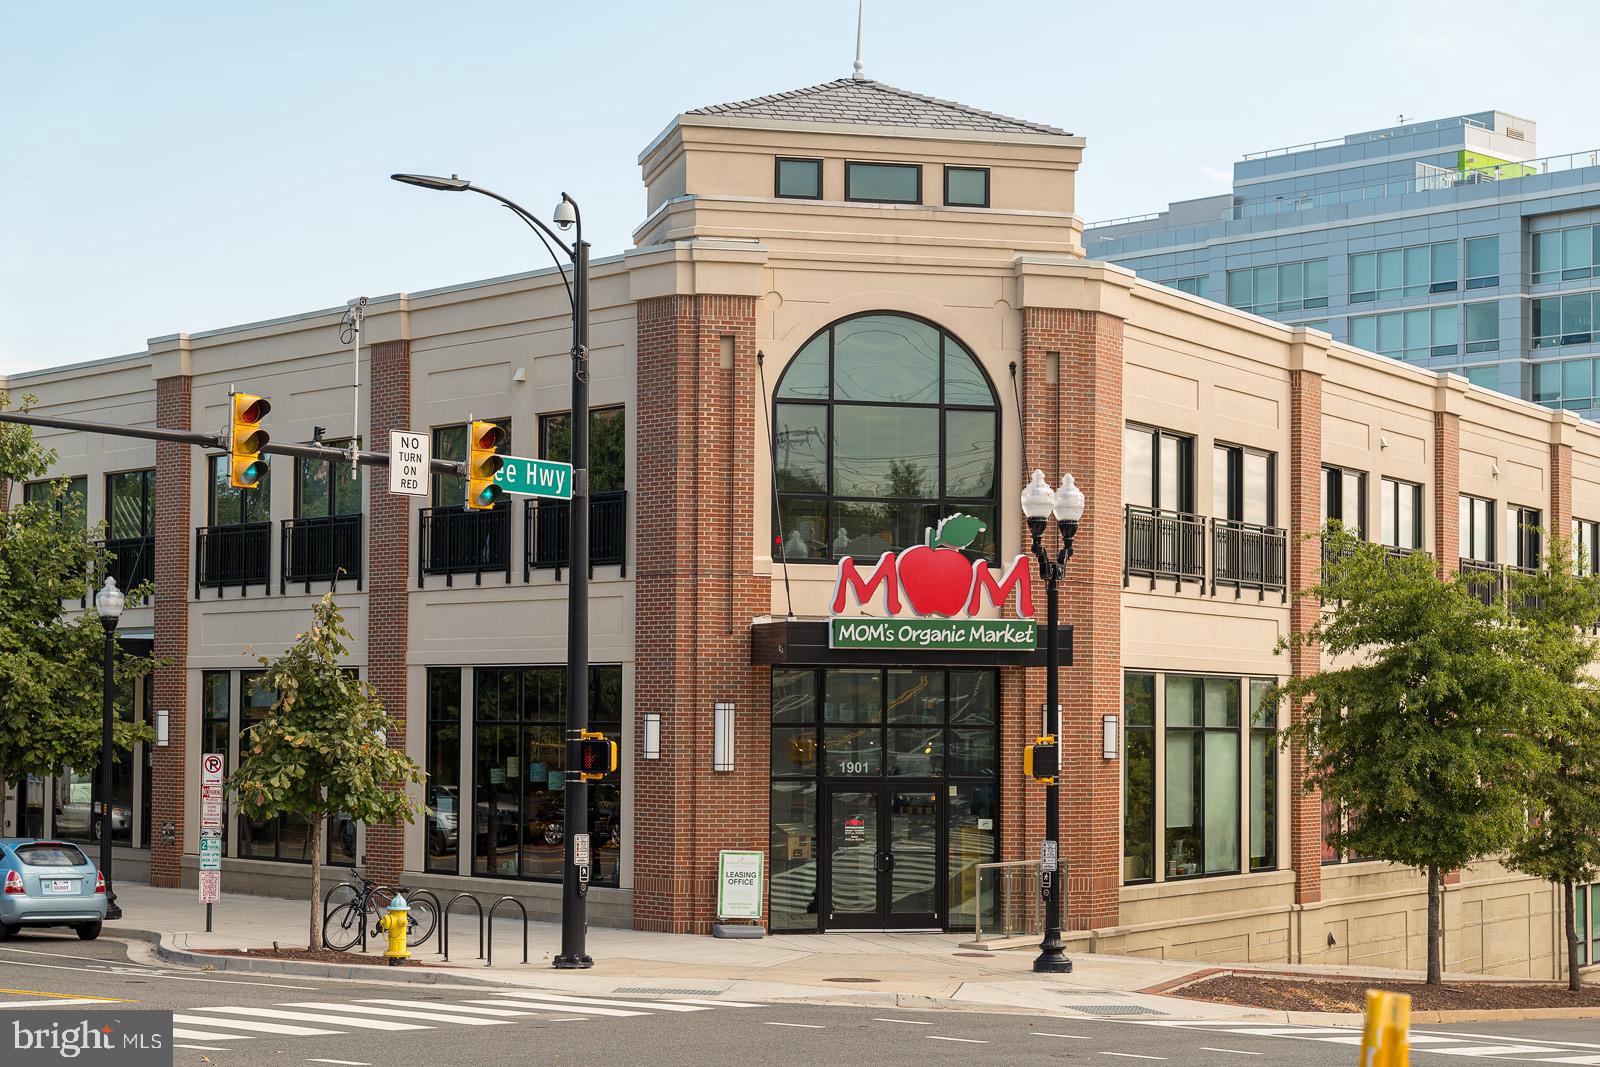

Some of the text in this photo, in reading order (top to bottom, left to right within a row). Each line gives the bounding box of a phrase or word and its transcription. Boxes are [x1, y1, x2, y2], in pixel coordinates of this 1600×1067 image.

[401, 437, 419, 449] NO
[399, 451, 422, 463] TURN
[403, 466, 417, 476] ON
[400, 478, 418, 489] RED
[526, 463, 566, 494] Hwy
[838, 623, 1034, 645] MOM's Organic Market
[839, 761, 868, 773] 1901
[202, 840, 207, 850] 2
